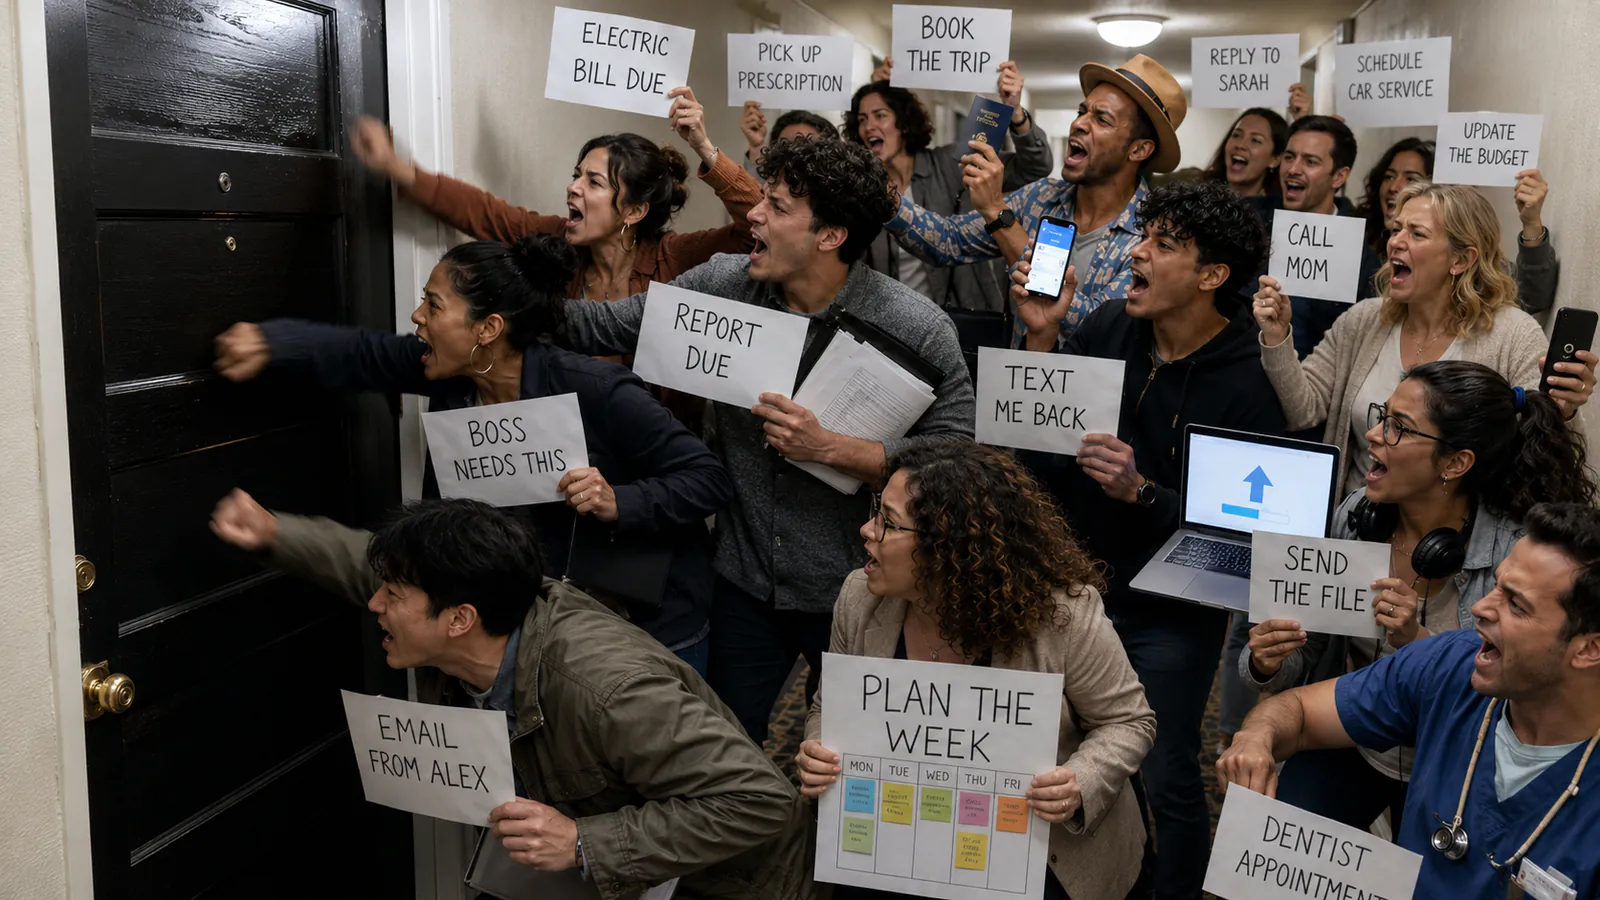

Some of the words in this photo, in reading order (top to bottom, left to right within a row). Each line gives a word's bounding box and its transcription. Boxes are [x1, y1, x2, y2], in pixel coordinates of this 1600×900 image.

[583, 22, 669, 56] ELECTRIC
[922, 15, 974, 39] BOOK
[759, 43, 793, 62] PICK
[802, 45, 821, 62] UP
[907, 50, 941, 71] THE
[949, 51, 990, 73] TRIP
[1211, 48, 1255, 65] REPLY
[1262, 47, 1280, 64] TO
[1357, 52, 1422, 73] SCHEDULE
[574, 58, 616, 86] BILL
[627, 67, 666, 94] DUE
[739, 71, 842, 92] PRESCRIPTION
[1219, 74, 1268, 91] SARAH
[1349, 83, 1372, 100] CAR
[1378, 79, 1434, 99] SERVICE
[1464, 122, 1516, 140] UPDATE
[1449, 147, 1473, 163] THE
[1478, 148, 1529, 166] BUDGET
[1288, 223, 1333, 247] CALL
[1286, 256, 1328, 282] MOM
[674, 303, 762, 347] REPORT
[685, 345, 731, 378] DUE
[1005, 366, 1074, 394] TEXT
[995, 400, 1022, 423] ME
[1034, 402, 1085, 430] BACK
[468, 417, 526, 447] BOSS
[454, 454, 516, 481] NEEDS
[522, 449, 566, 474] THIS
[1285, 545, 1348, 575] SEND
[1269, 579, 1310, 606] THE
[1321, 585, 1367, 612] FILE
[863, 675, 951, 717] PLAN
[970, 686, 1034, 726] THE
[378, 714, 458, 749] EMAIL
[886, 721, 990, 764] WEEK
[369, 749, 420, 781] FROM
[431, 760, 489, 793] ALEX
[851, 761, 873, 772] MON
[889, 765, 909, 777] TUE
[926, 770, 949, 781] WED
[965, 774, 986, 785] THU
[1004, 779, 1020, 789] FRI
[1262, 815, 1372, 872] DENTIST
[1235, 849, 1388, 900] APPOINTME
